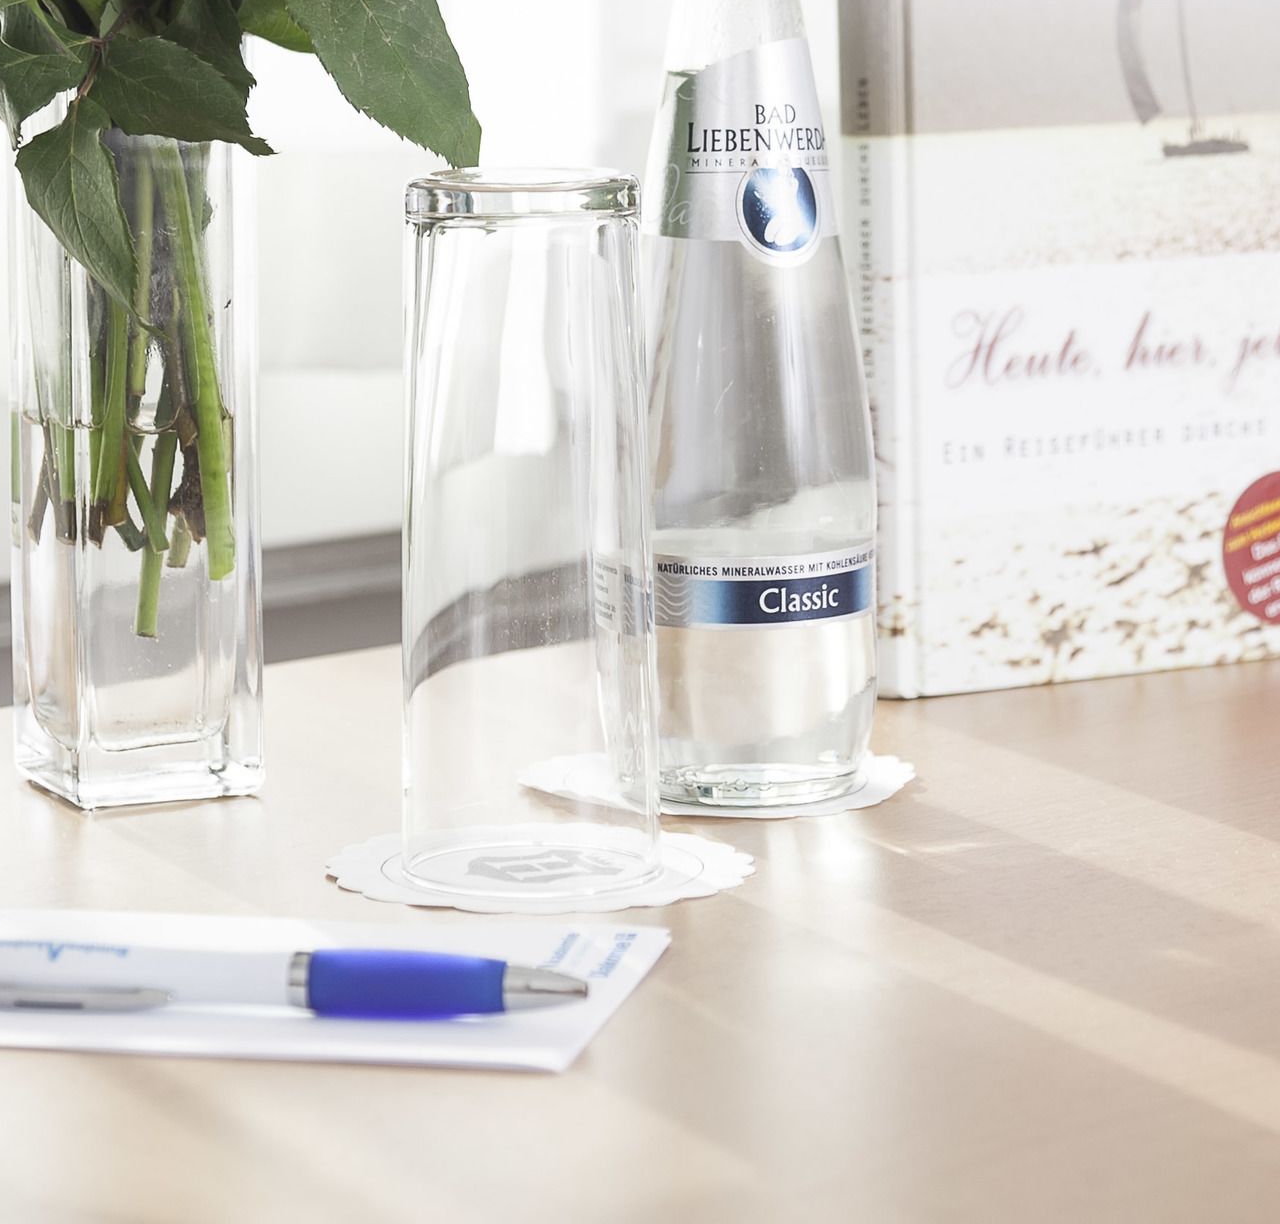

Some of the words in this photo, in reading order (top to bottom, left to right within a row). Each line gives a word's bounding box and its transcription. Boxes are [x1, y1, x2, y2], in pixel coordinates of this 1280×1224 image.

[755, 104, 796, 125] BAD
[945, 304, 1102, 390] Heute,
[1124, 309, 1218, 372] hier,
[657, 562, 718, 576] NATÜRLICHES
[721, 563, 805, 577] MINERALWASSER
[808, 562, 823, 573] MIT
[826, 552, 868, 571] KOHLENSÄURE
[759, 583, 839, 614] Classic
